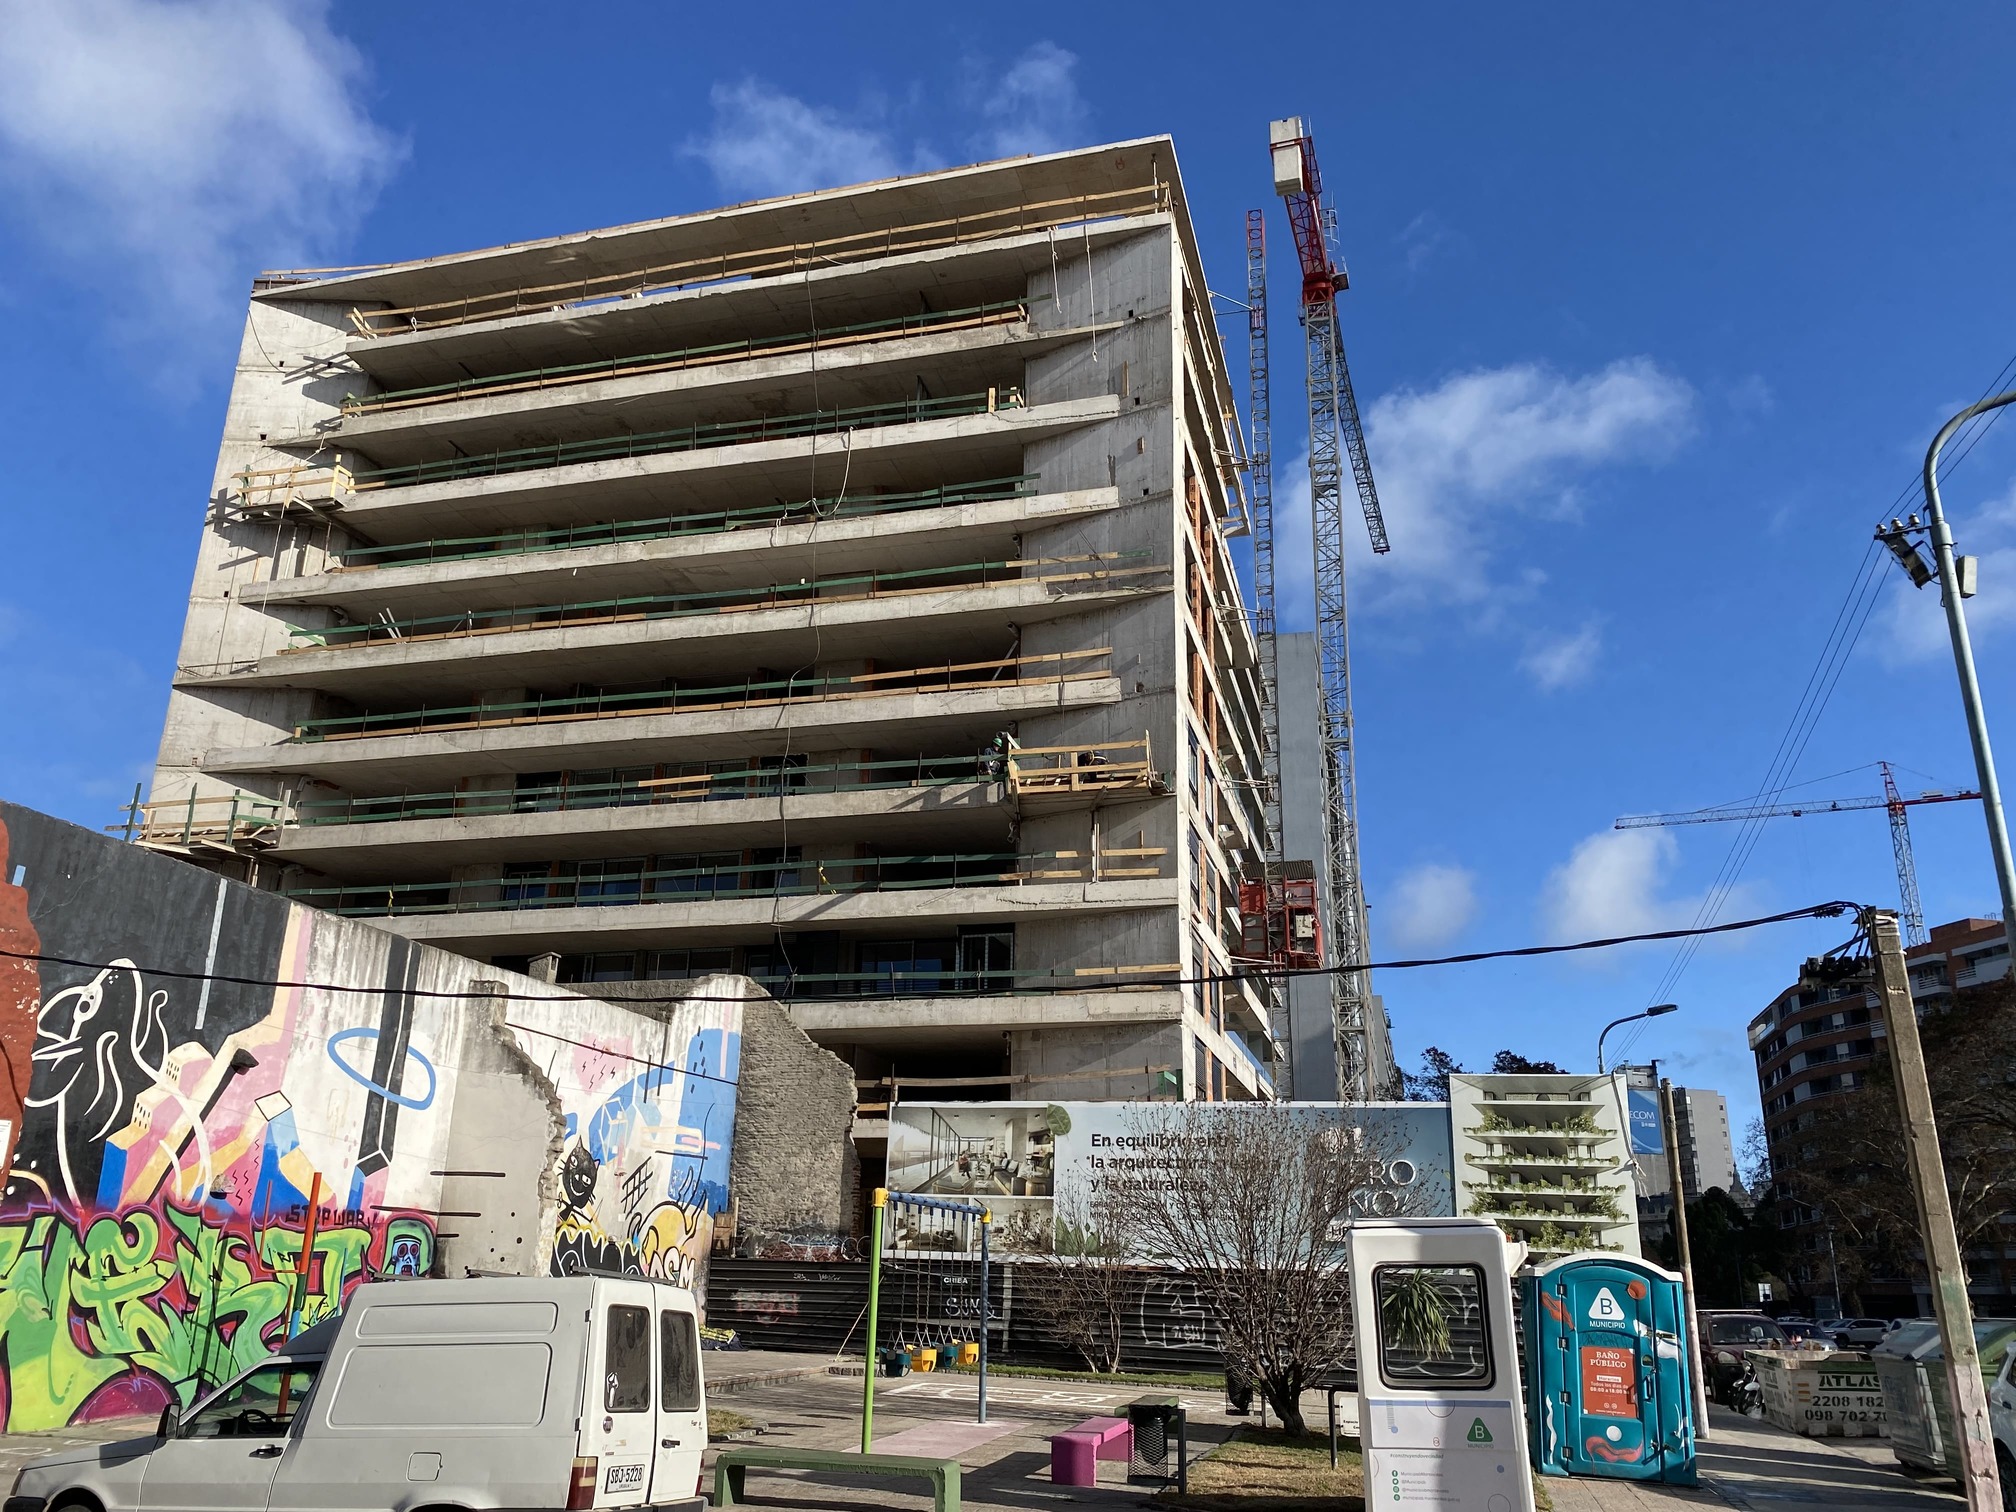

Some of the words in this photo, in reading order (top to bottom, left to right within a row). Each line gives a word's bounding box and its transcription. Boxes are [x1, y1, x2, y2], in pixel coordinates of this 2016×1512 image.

[1091, 1134, 1111, 1147] En
[1116, 1133, 1193, 1150] equilibrio
[1198, 1134, 1240, 1147] ente
[1090, 1155, 1105, 1169] la
[1322, 1159, 1416, 1186] ERO
[1091, 1178, 1100, 1192] y
[1600, 1298, 1612, 1315] B
[1589, 1320, 1626, 1329] MUNICIPIO
[1596, 1351, 1620, 1360] BAÑO
[1590, 1357, 1627, 1368] PÚBLICO
[1819, 1375, 1880, 1388] ATLAS
[1812, 1396, 1850, 1407] 2208
[1857, 1396, 1884, 1408] 182
[1805, 1410, 1833, 1421] 098
[1839, 1411, 1867, 1422] 702
[1475, 1425, 1485, 1439] B
